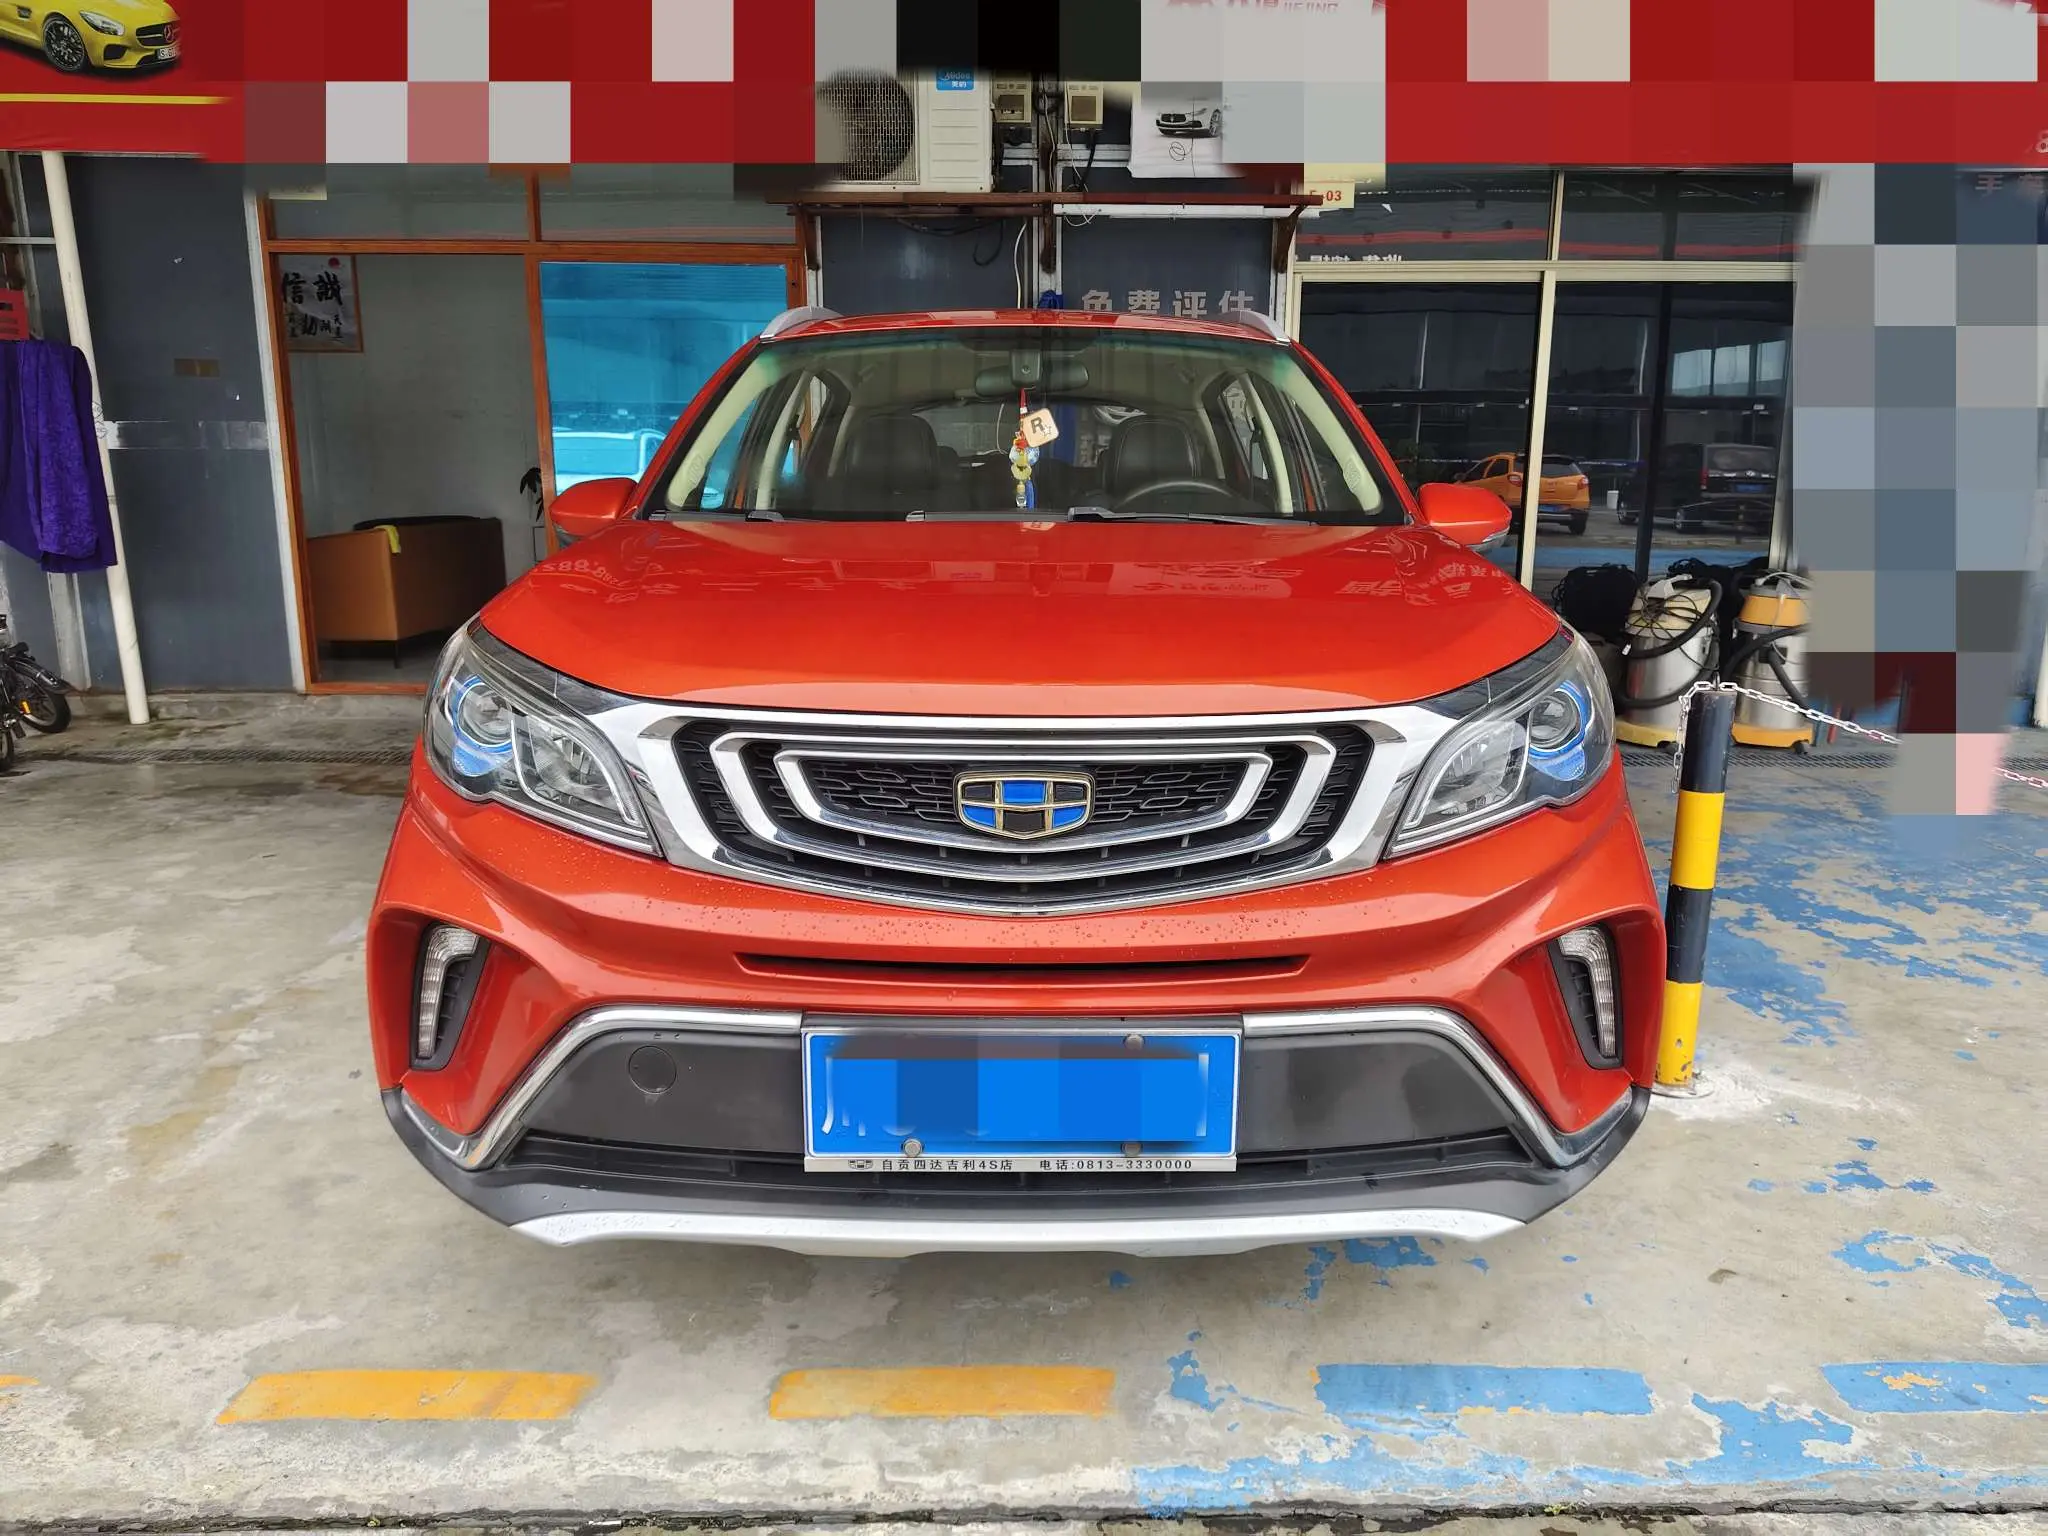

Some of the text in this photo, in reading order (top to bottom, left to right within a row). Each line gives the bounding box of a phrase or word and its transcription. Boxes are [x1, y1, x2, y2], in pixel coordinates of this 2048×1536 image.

[881, 1159, 1013, 1171] 自贡四达吉利4S店
[1039, 1159, 1193, 1171] 电话:0813-3330000
